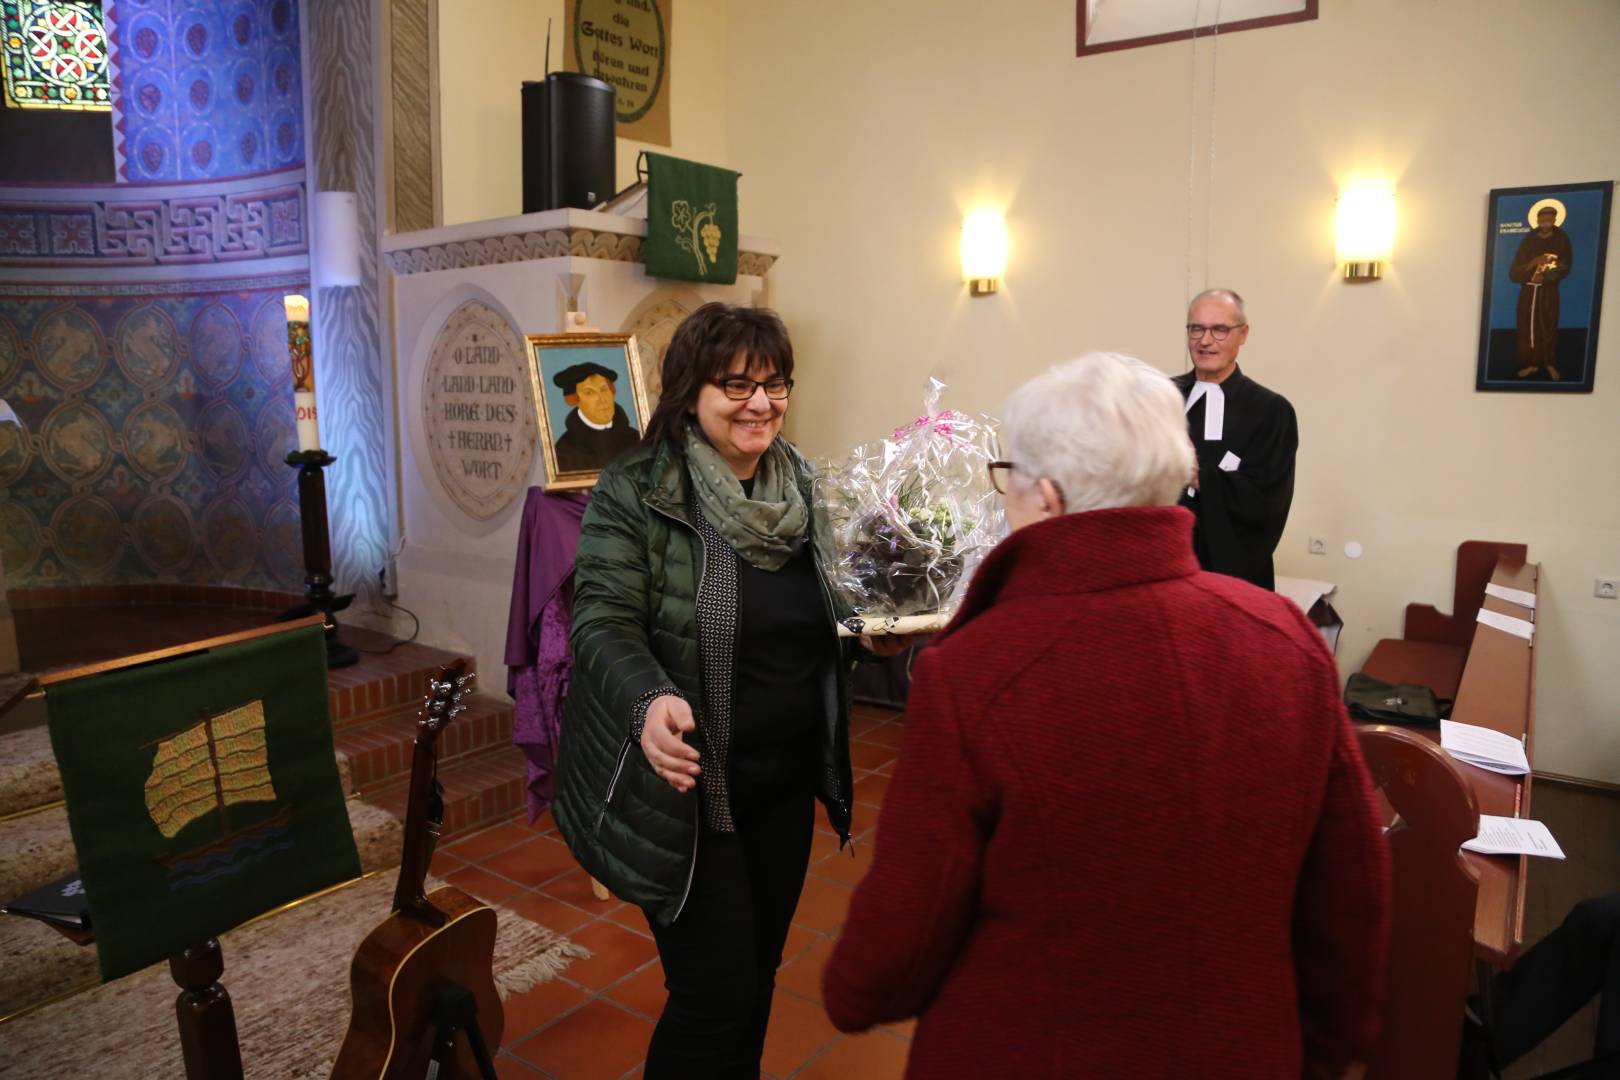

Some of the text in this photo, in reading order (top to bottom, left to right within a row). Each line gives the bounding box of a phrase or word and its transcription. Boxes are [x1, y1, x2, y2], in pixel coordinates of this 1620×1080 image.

[613, 13, 630, 28] die
[581, 20, 658, 57] Gottes Wort
[628, 62, 649, 77] und
[454, 346, 500, 365] O LAND
[443, 375, 514, 394] LAND LAND
[485, 403, 516, 423] DES
[461, 459, 502, 480] WORT
